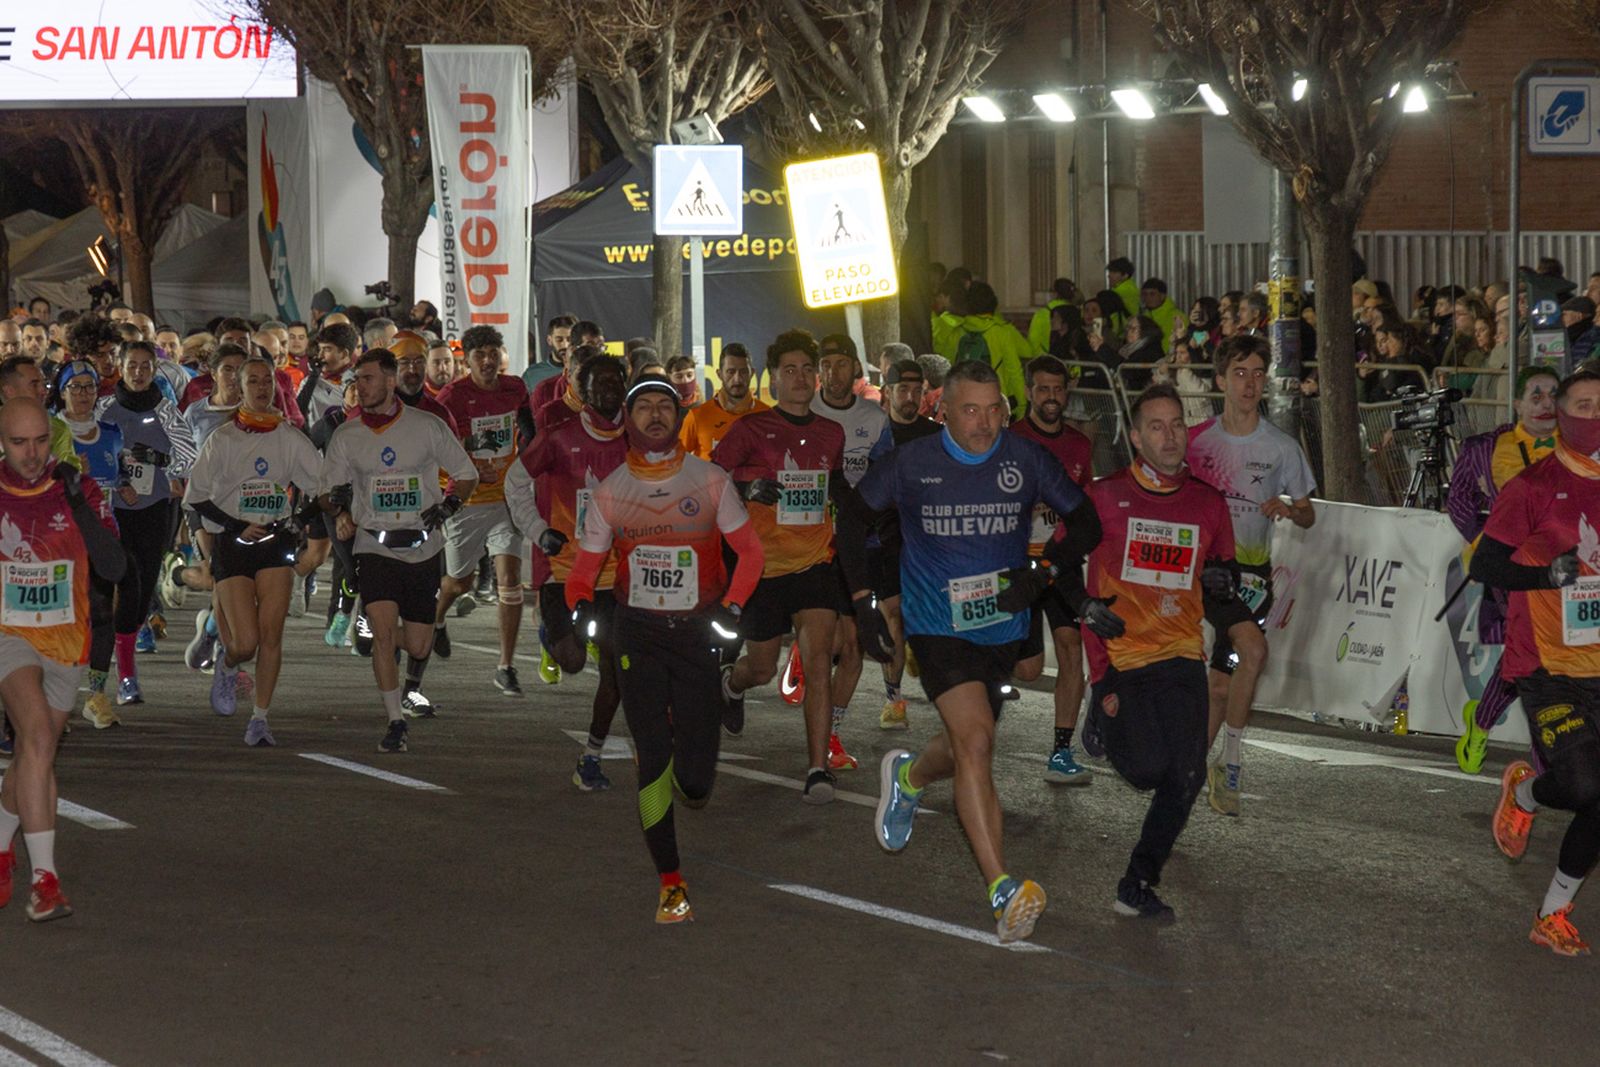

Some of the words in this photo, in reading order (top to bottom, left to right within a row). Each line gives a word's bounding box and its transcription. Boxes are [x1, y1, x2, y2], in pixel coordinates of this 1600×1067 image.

[32, 26, 120, 61] SAN
[127, 15, 273, 60] ANTÓN
[791, 158, 875, 184] ATENCIÓN
[825, 263, 871, 281] PASO
[811, 279, 891, 303] ELEVADO
[243, 495, 284, 510] 12060
[377, 491, 417, 508] 13475
[785, 489, 824, 506] 13330
[921, 504, 952, 517] CLUB
[955, 502, 1021, 516] DEPORTIVO
[921, 515, 1019, 536] BULEVAR
[1144, 526, 1164, 535] NOCHE
[1165, 528, 1173, 536] DE
[1135, 534, 1149, 542] SAN
[13, 546, 32, 563] 43
[636, 558, 649, 566] SAN
[643, 552, 662, 560] NOCHE
[663, 553, 671, 561] DE
[1140, 543, 1182, 566] 9812
[17, 567, 40, 577] NOCHE
[41, 567, 48, 577] DE
[641, 567, 684, 588] 7662
[9, 577, 24, 585] SAN
[1336, 555, 1404, 609] XAVE
[17, 584, 58, 605] 7401
[1571, 592, 1587, 600] SAN
[962, 596, 997, 621] 855
